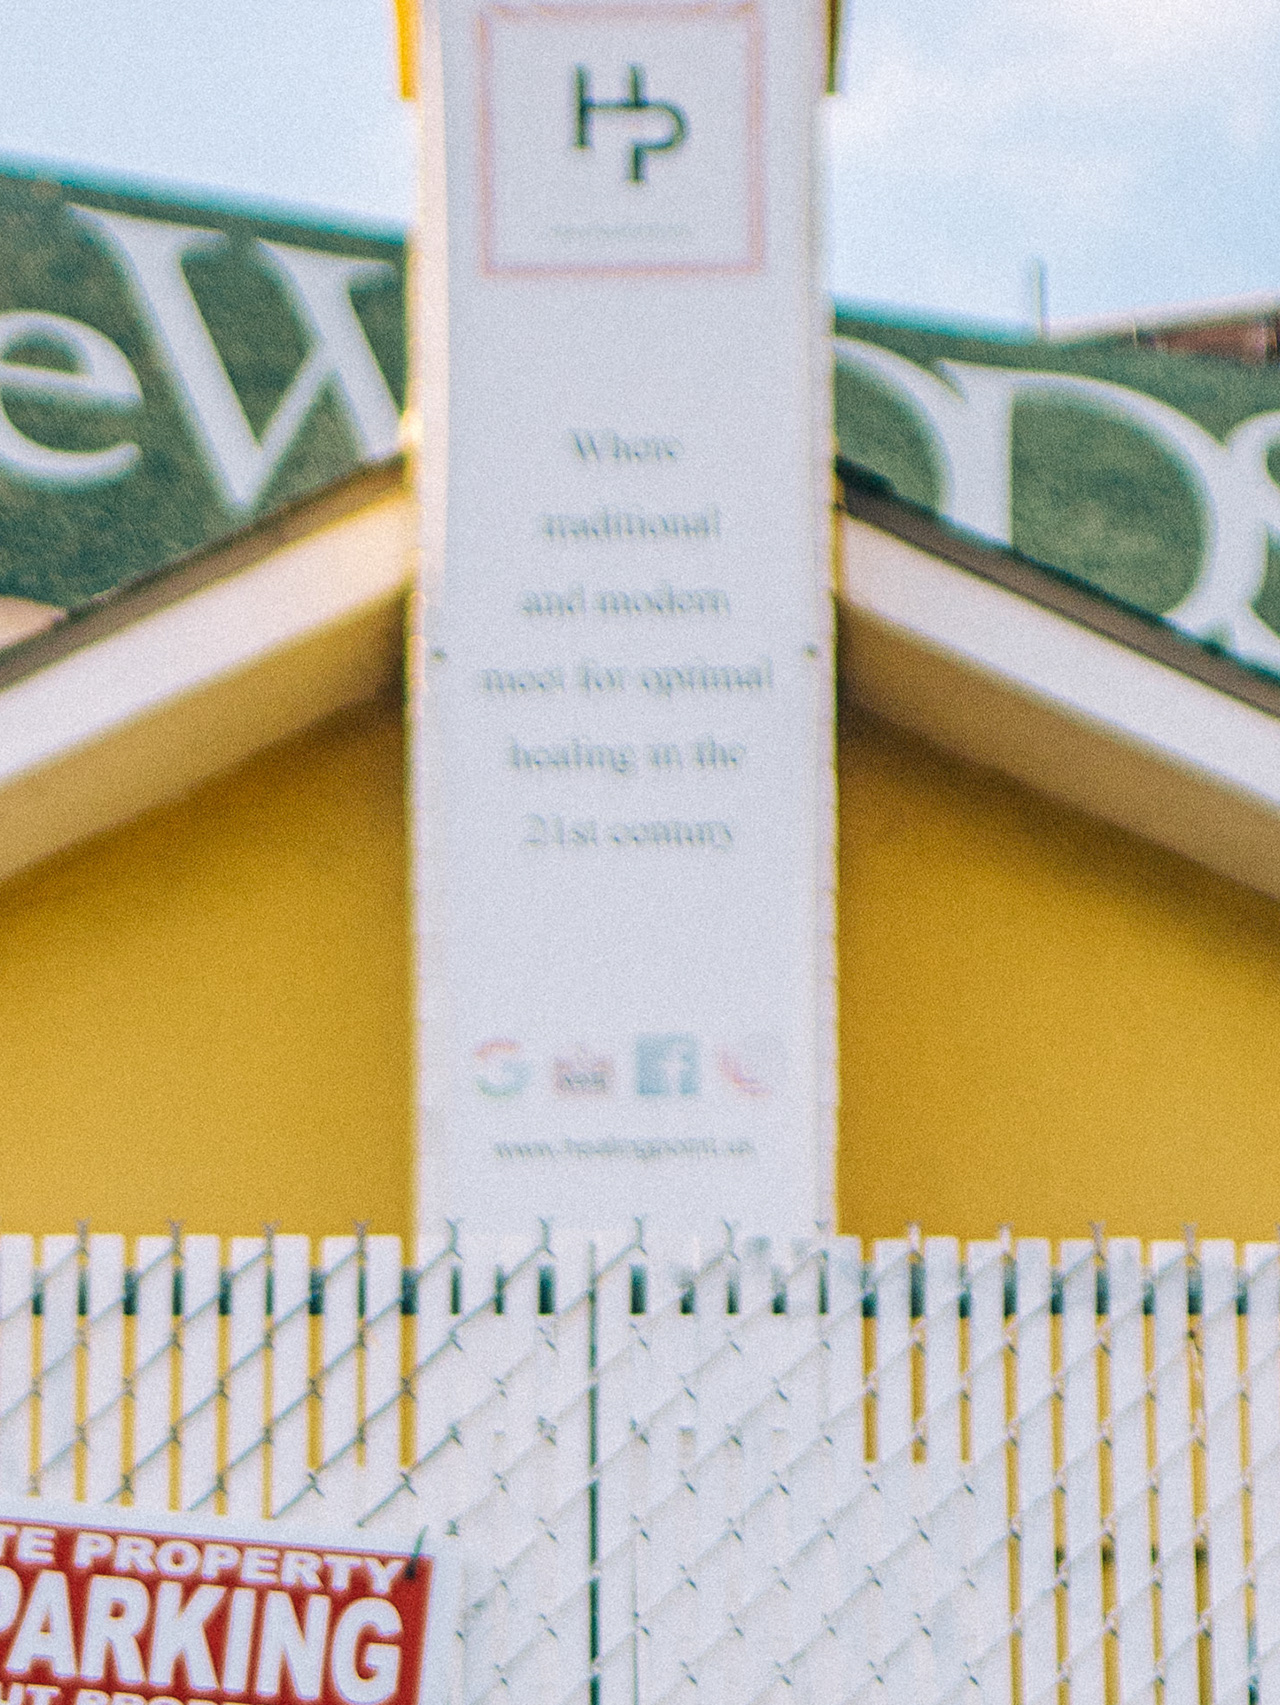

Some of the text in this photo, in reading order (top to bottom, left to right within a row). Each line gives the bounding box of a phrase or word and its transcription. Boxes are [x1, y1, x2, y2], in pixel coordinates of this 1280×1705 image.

[569, 428, 684, 464] Where
[540, 508, 721, 541] traditional
[520, 581, 731, 617] and modern
[577, 660, 627, 692] for
[640, 657, 775, 697] optimal
[507, 737, 746, 774] healing in the
[525, 814, 734, 853] 21st century
[73, 1532, 407, 1594] PROPERTY
